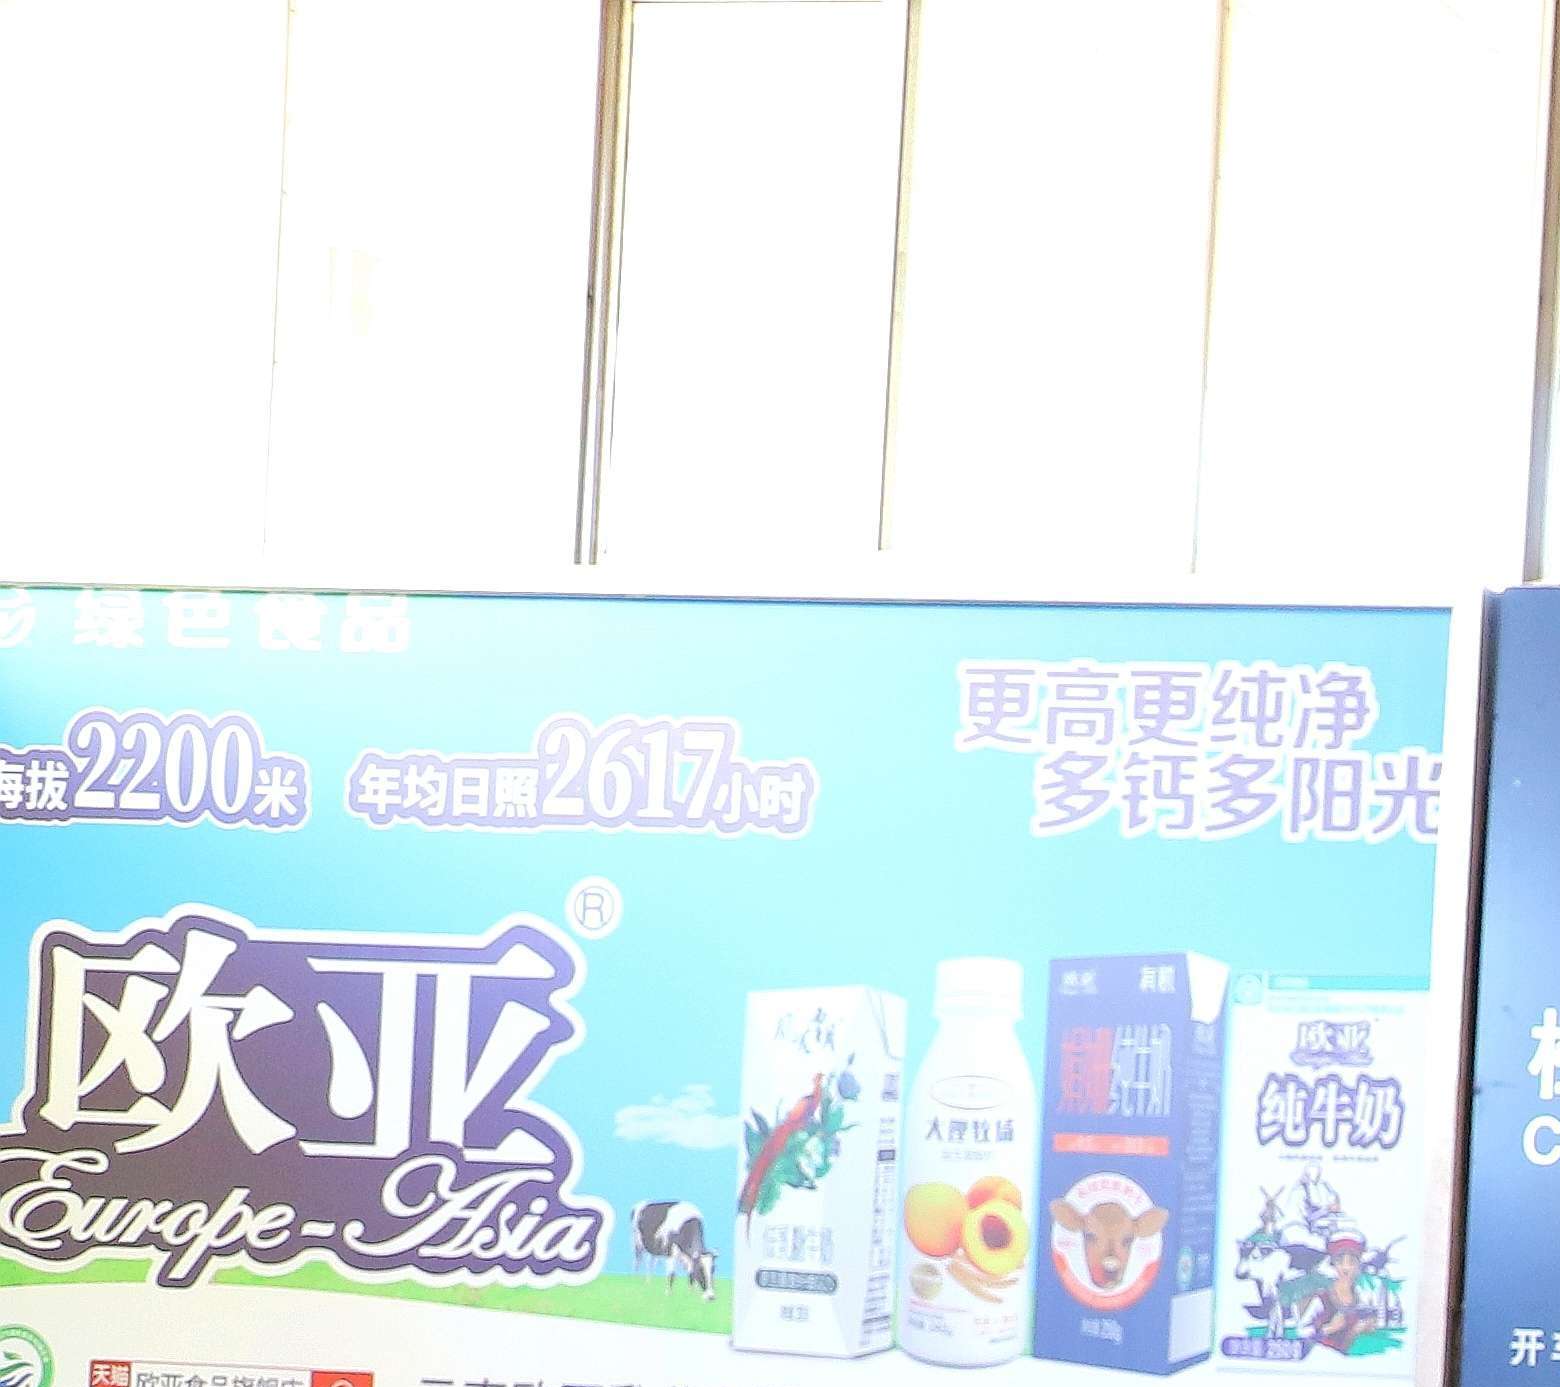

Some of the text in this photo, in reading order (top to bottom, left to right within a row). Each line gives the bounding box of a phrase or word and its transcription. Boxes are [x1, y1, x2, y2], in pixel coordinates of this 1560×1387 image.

[960, 665, 1376, 750] 更高更纯净
[0, 717, 808, 828] 海拔2200米 年均日照2617小时
[1037, 750, 1445, 836] 多钙多阳光
[38, 927, 558, 1163] 欧亚
[1254, 1071, 1406, 1151] 纯牛奶
[0, 1147, 595, 1279] Europe-Asia
